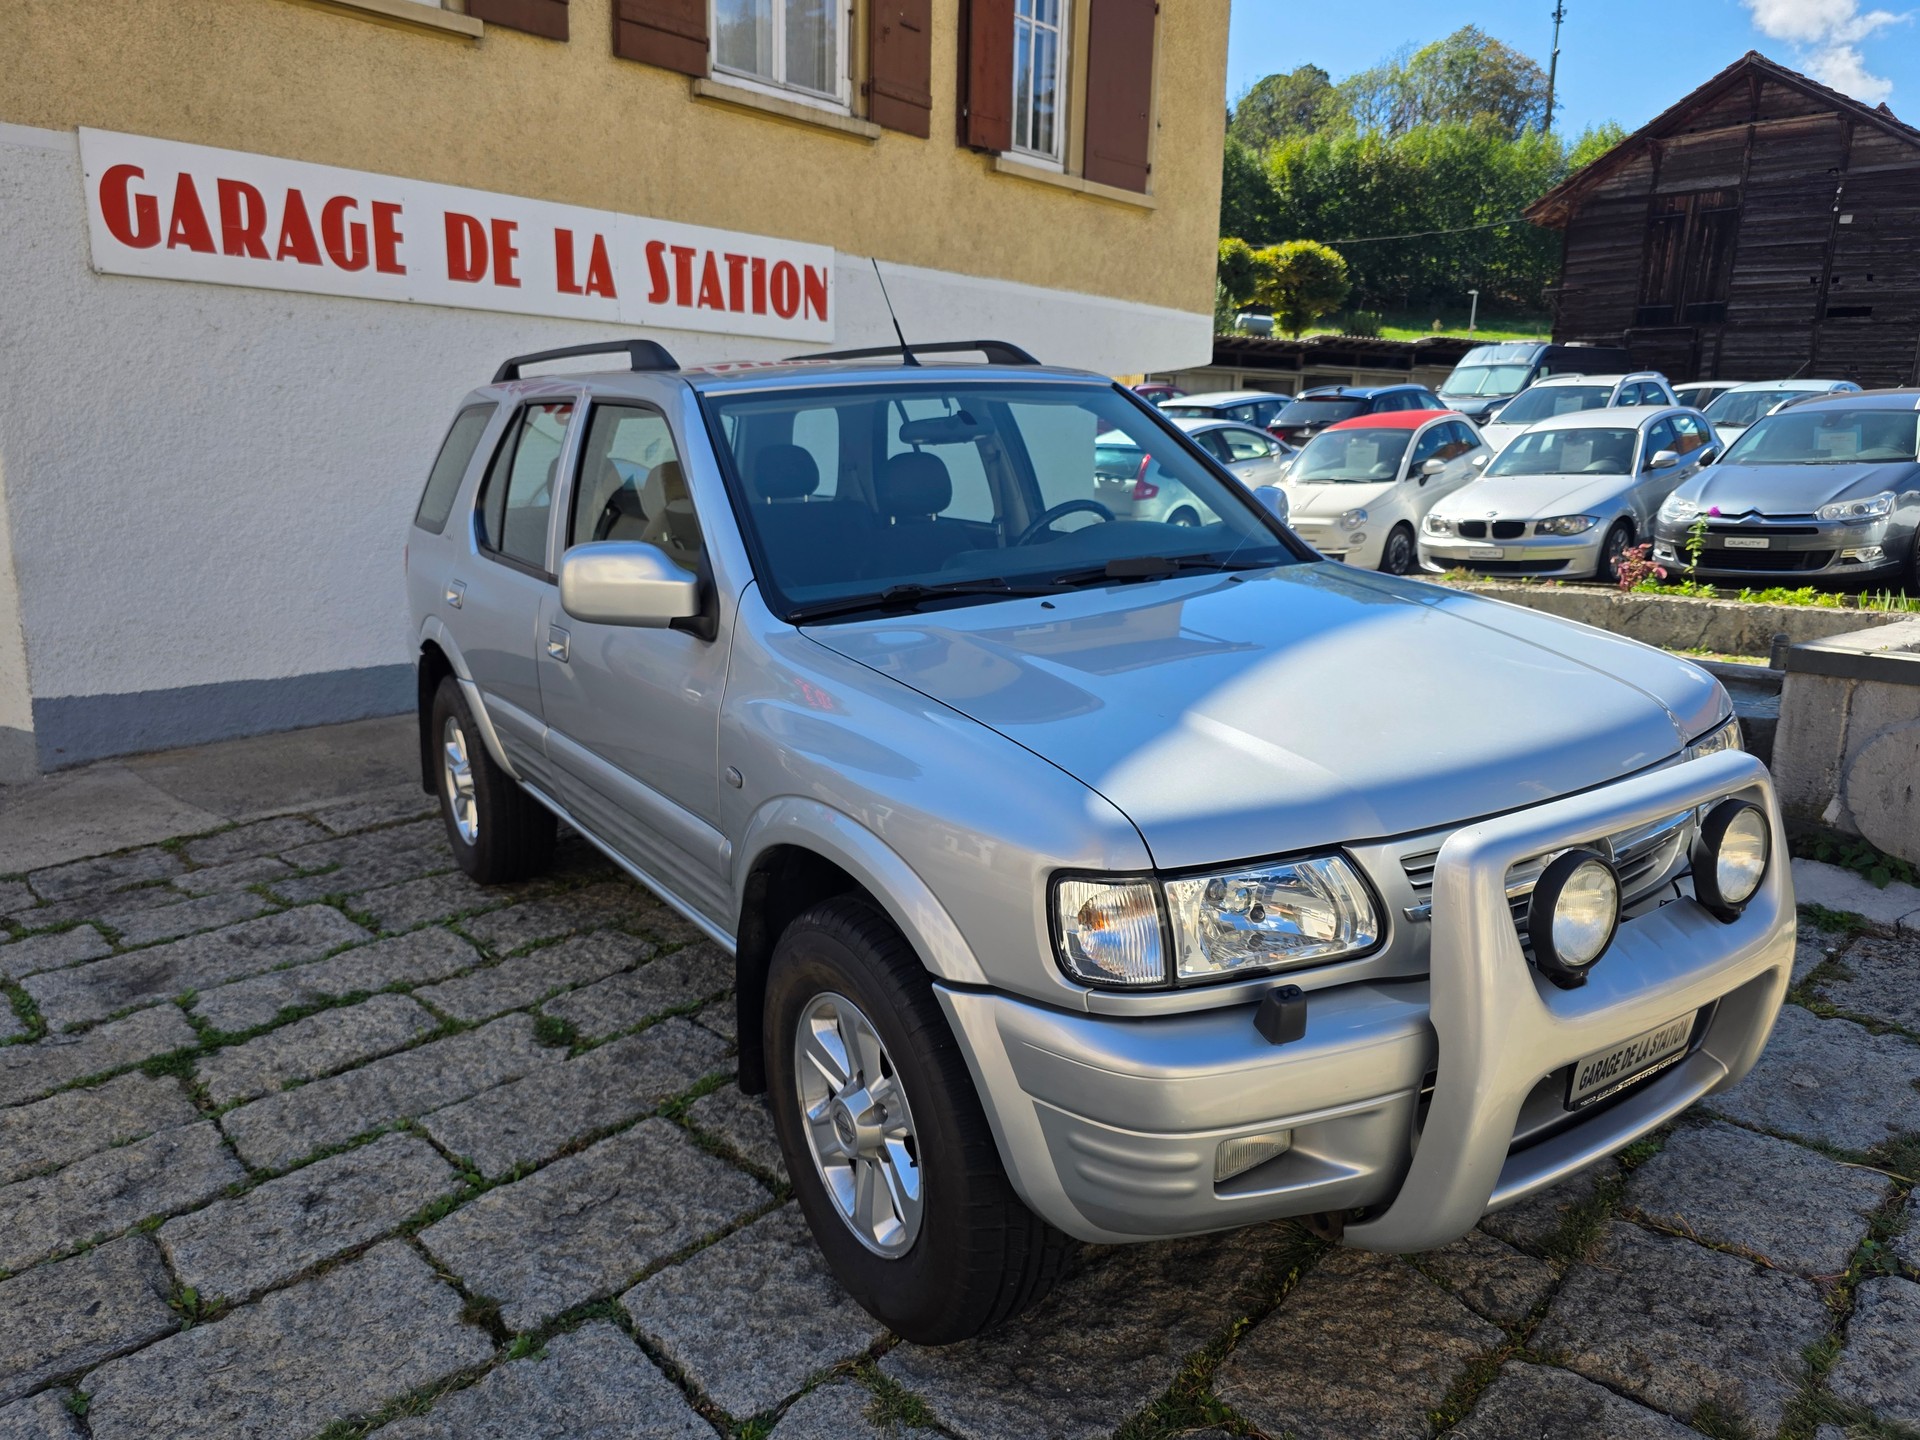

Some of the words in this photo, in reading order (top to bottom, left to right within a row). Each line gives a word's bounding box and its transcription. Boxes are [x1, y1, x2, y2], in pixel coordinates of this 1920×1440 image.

[99, 165, 406, 275] GARAGE
[445, 212, 520, 286] DE
[555, 229, 617, 299] LA
[645, 240, 828, 321] STATION
[1579, 1050, 1623, 1091] GARAGE
[1620, 1043, 1638, 1071] DE
[1634, 1037, 1651, 1064] LA
[1649, 1017, 1692, 1057] STATION
